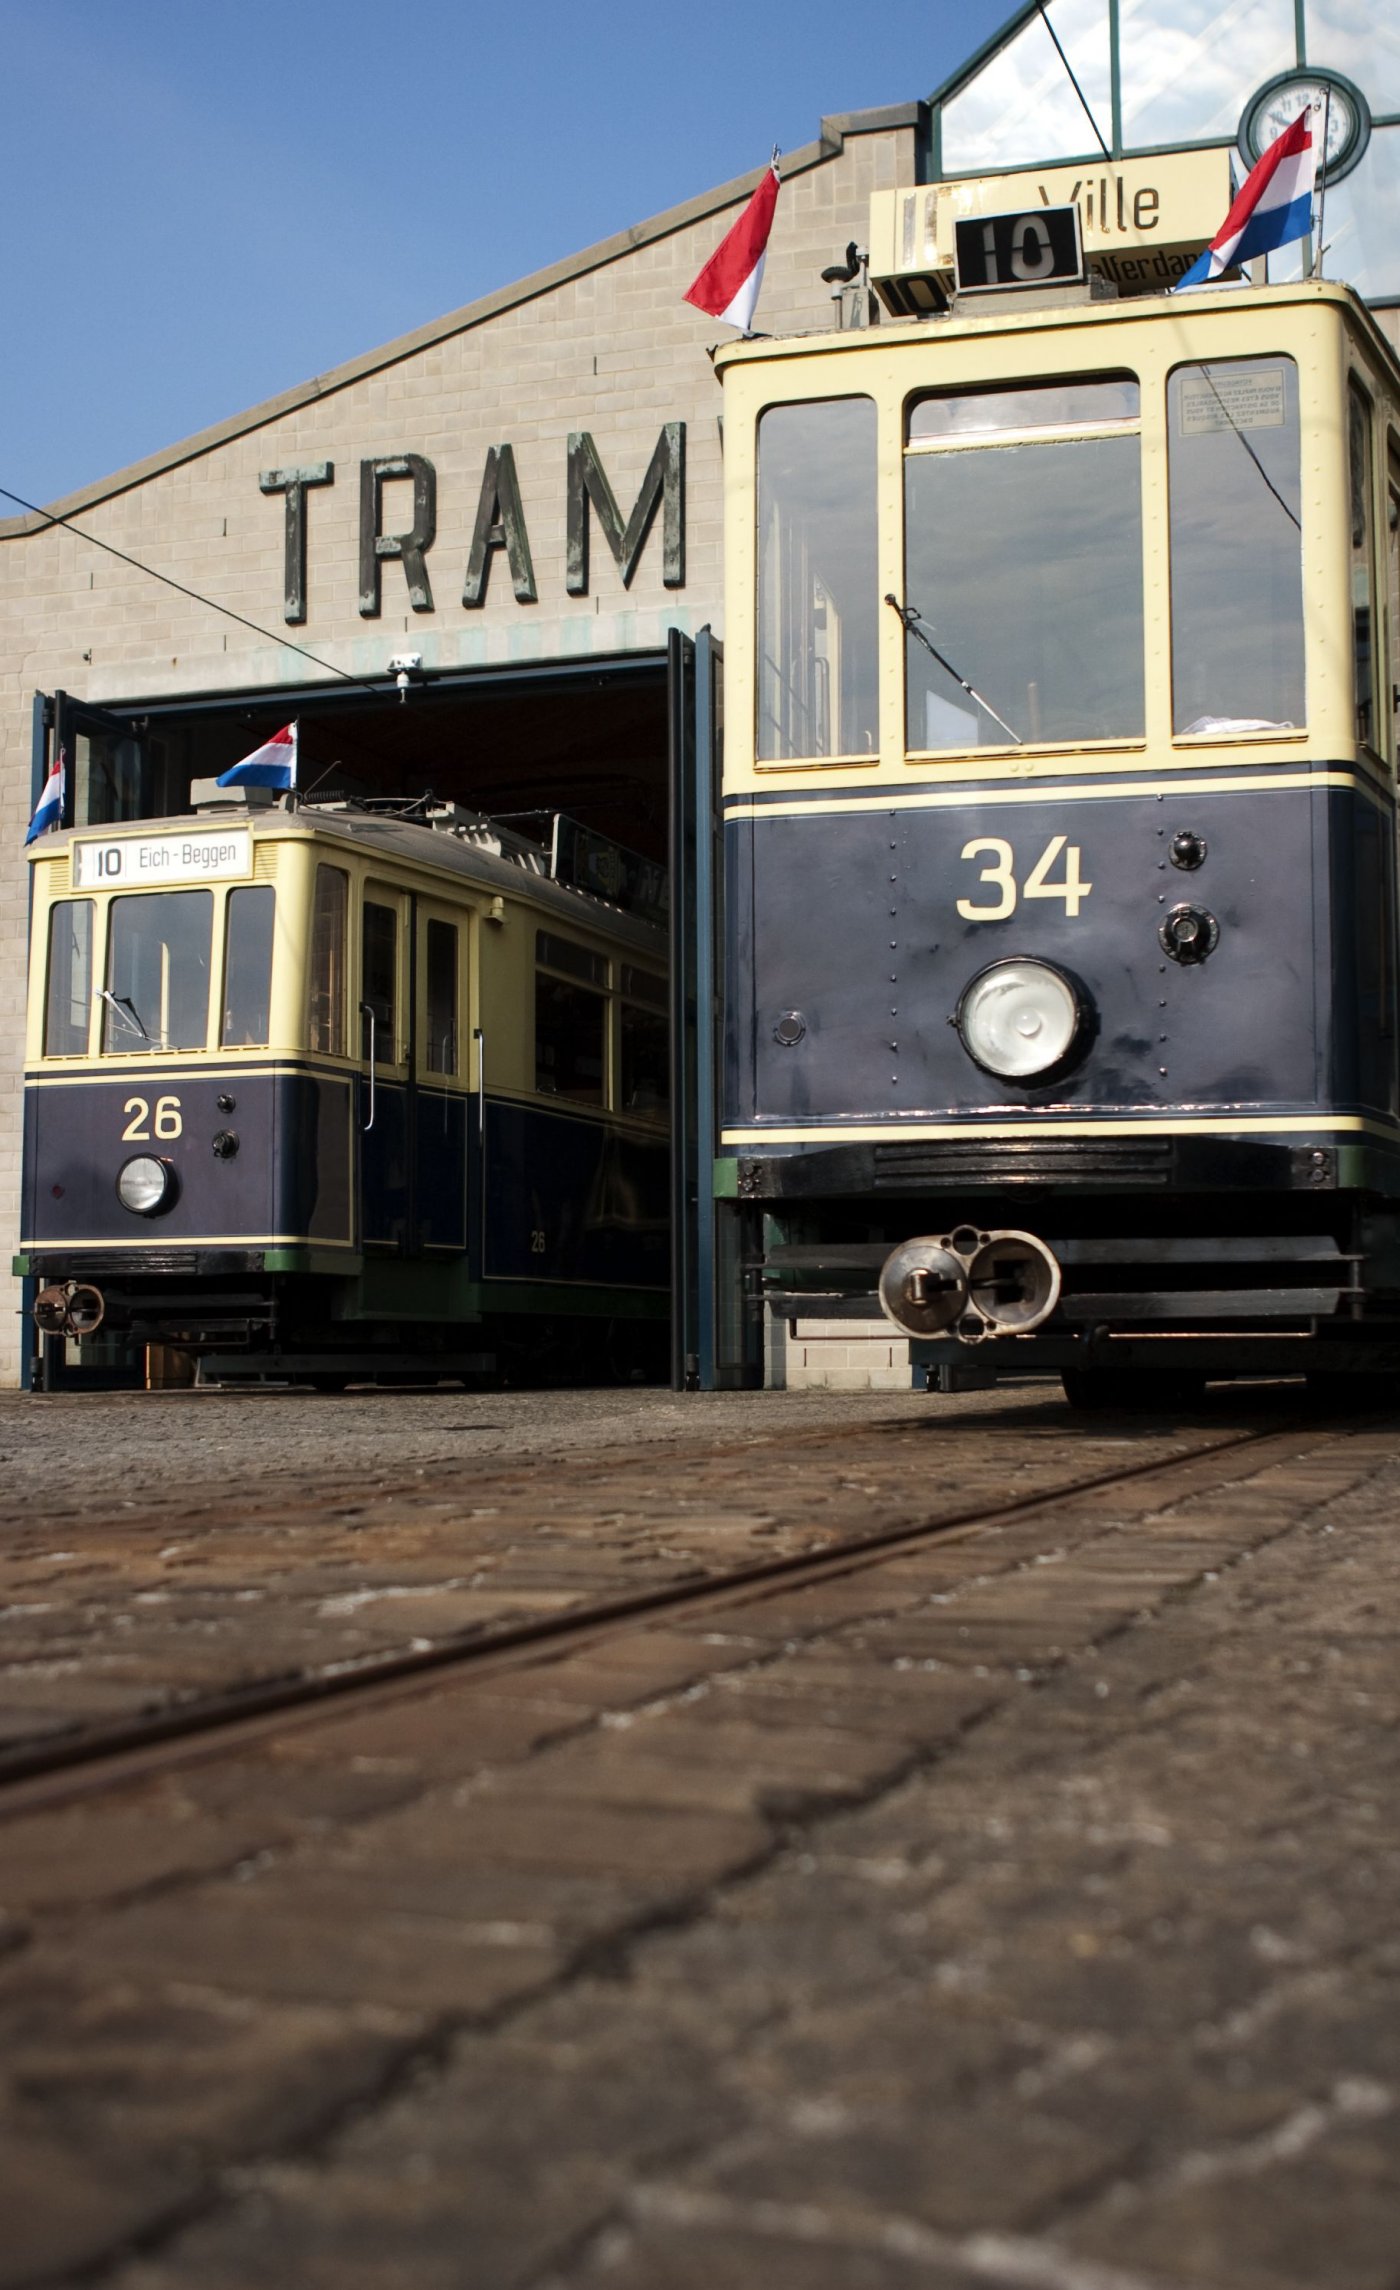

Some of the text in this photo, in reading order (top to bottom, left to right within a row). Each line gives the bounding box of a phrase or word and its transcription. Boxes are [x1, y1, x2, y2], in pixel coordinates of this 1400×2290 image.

[983, 215, 1055, 284] 10
[881, 275, 950, 316] 10
[259, 416, 723, 626] TRAM
[98, 848, 122, 877] 10
[956, 836, 1093, 921] 34
[122, 1095, 183, 1141] 26
[530, 1229, 546, 1254] 26
